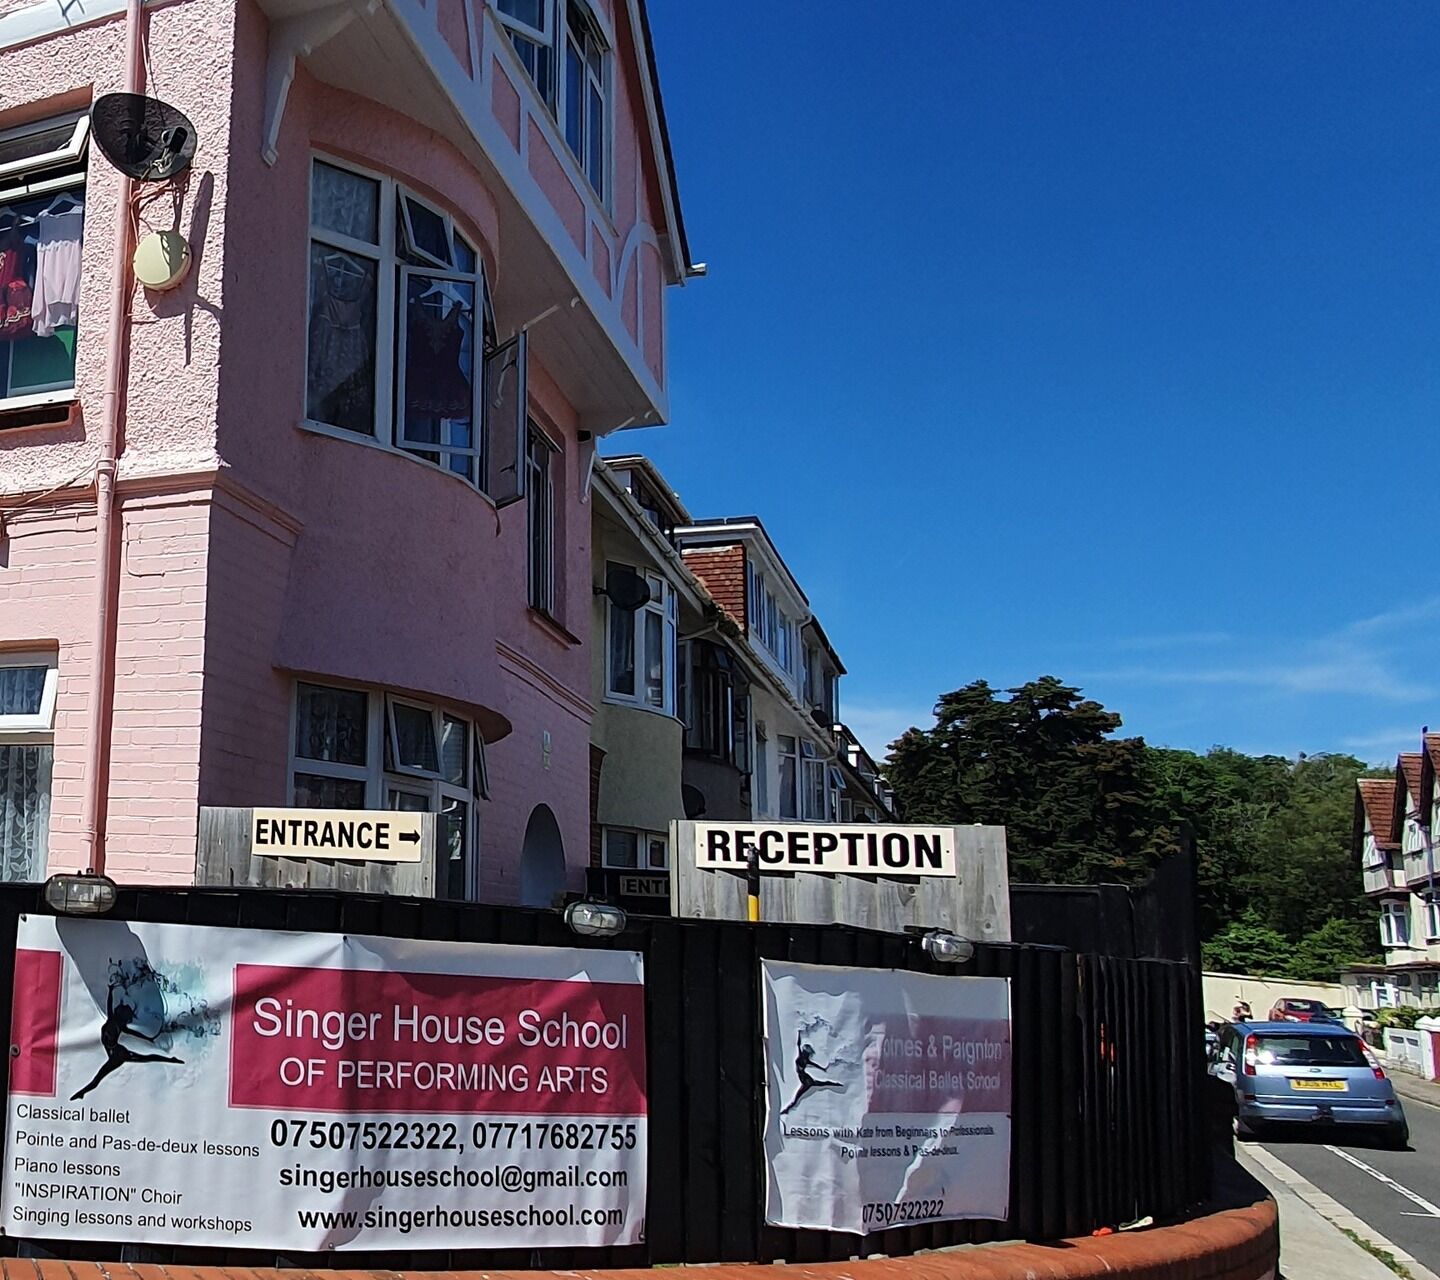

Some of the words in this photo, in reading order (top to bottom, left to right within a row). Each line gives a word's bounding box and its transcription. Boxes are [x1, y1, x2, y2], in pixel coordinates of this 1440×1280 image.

[254, 818, 390, 850] ENTRANCE
[706, 829, 943, 869] RECEPTION
[253, 997, 382, 1051] Singer
[393, 1004, 506, 1046] House
[517, 1009, 628, 1050] School
[926, 1034, 938, 1058] &
[942, 1034, 1003, 1065] Paignton
[278, 1057, 327, 1087] OF
[336, 1060, 529, 1093] PERFORMING
[536, 1065, 609, 1095] ARTS
[874, 1068, 926, 1090] Classical
[928, 1070, 965, 1090] Ballet
[966, 1071, 1001, 1091] School
[16, 1103, 85, 1122] Classical
[89, 1107, 130, 1124] ballet
[15, 1130, 64, 1147] Pointe
[68, 1134, 97, 1150] and
[102, 1135, 198, 1155] Pas-de-deux
[203, 1140, 260, 1158] lessons
[269, 1118, 464, 1155] 07507522322,
[471, 1121, 637, 1151] 07717682755
[783, 1124, 830, 1138] Lessons
[832, 1126, 854, 1138] with
[856, 1126, 874, 1138] Kate
[875, 1125, 893, 1137] from
[939, 1126, 948, 1137] to
[870, 1145, 901, 1157] lessons
[903, 1145, 910, 1157] &
[14, 1157, 58, 1174] Piano
[62, 1159, 121, 1177] lessons
[279, 1163, 628, 1194] singerhouseschool@gmail.com
[15, 1182, 137, 1203] "INSPIRATION"
[141, 1188, 183, 1206] Choir
[12, 1205, 70, 1227] Singing
[74, 1209, 133, 1227] lessons
[137, 1213, 166, 1228] and
[170, 1216, 253, 1235] workshops
[297, 1204, 624, 1234] www.singerhouseschool.com
[862, 1199, 944, 1224] 07507522322
